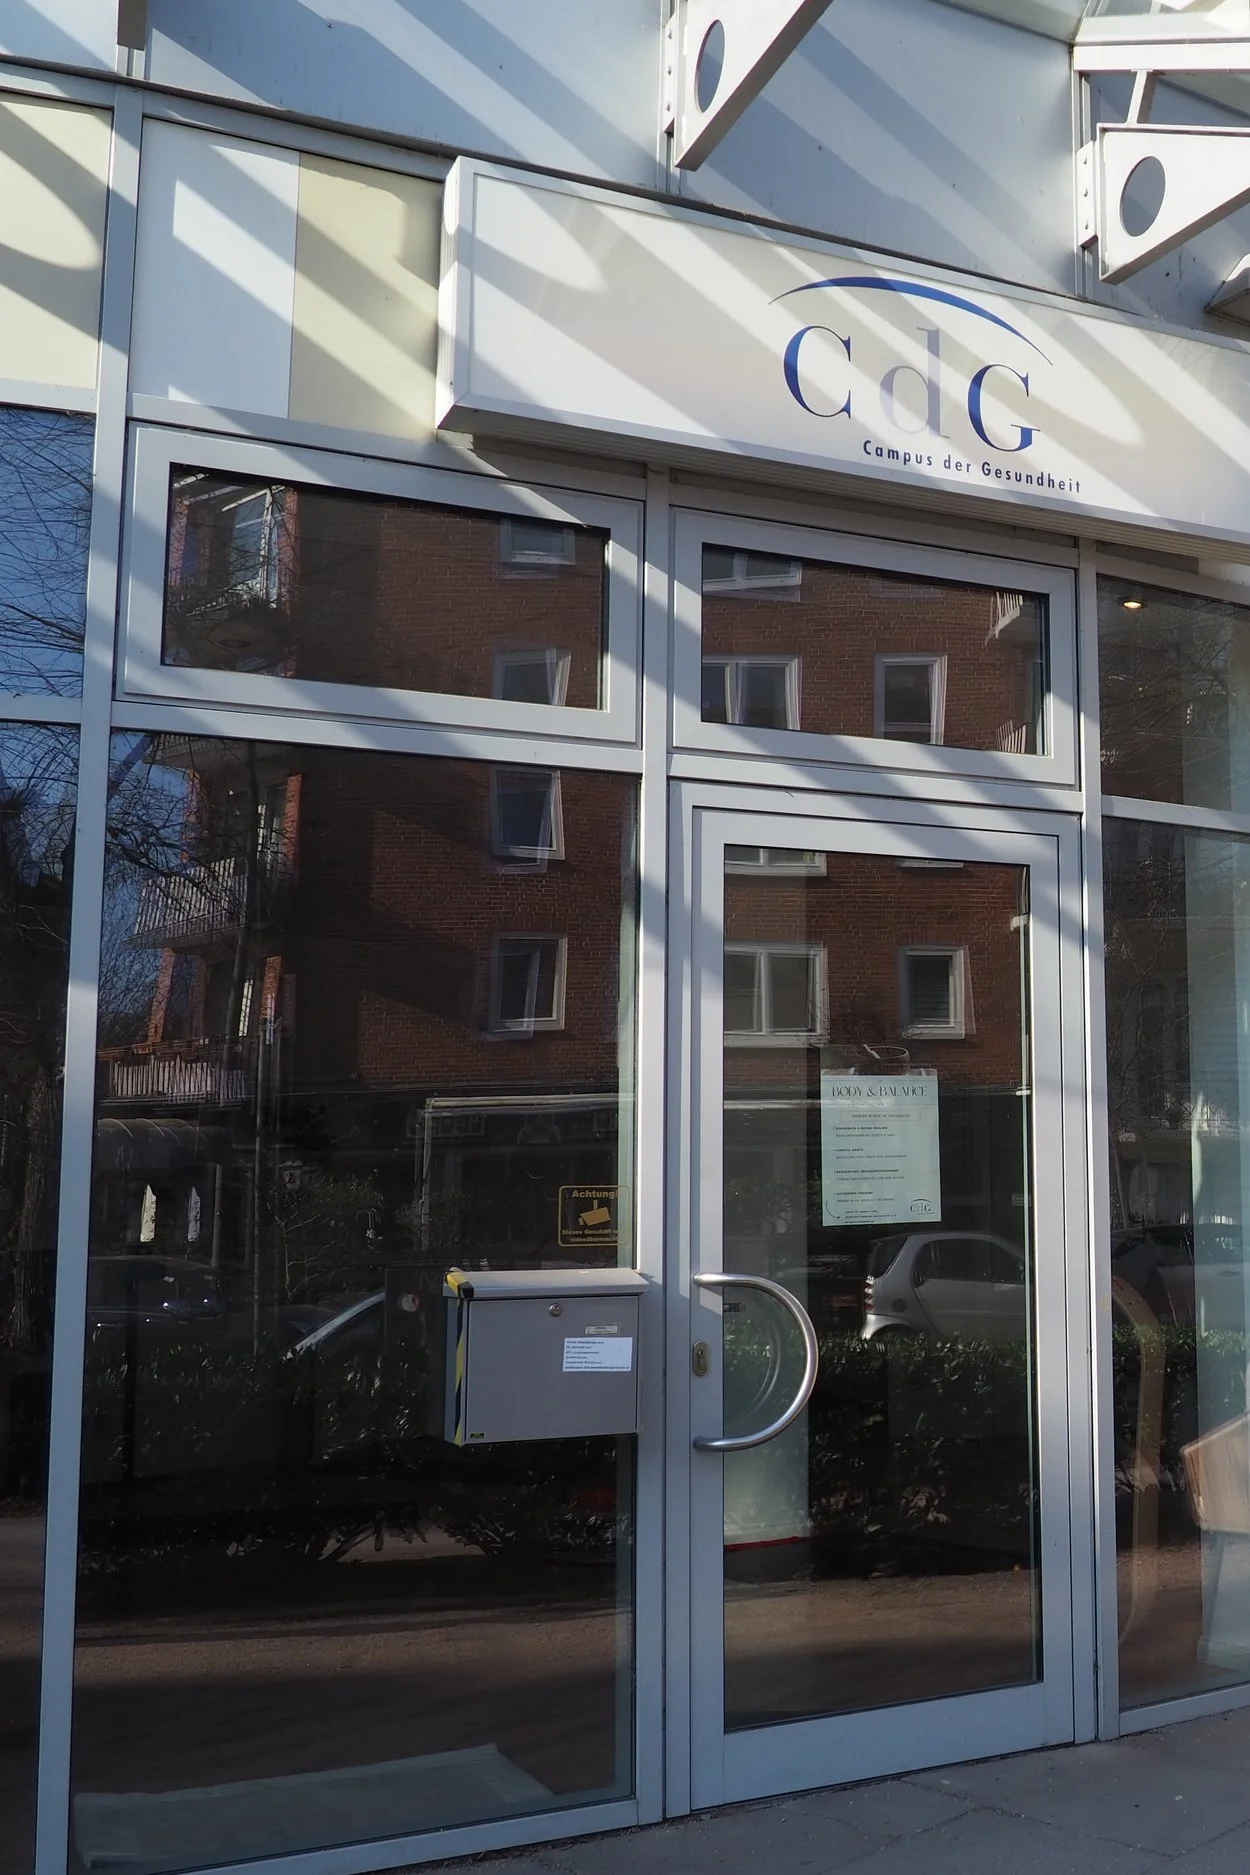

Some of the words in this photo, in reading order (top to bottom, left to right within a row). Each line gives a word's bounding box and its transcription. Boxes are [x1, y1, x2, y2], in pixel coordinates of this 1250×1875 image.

[783, 325, 1041, 452] CdG
[863, 439, 933, 467] Campus
[943, 454, 973, 473] der
[981, 461, 1081, 494] Gesundheit
[832, 1086, 862, 1097] BODY
[866, 1086, 876, 1098] &
